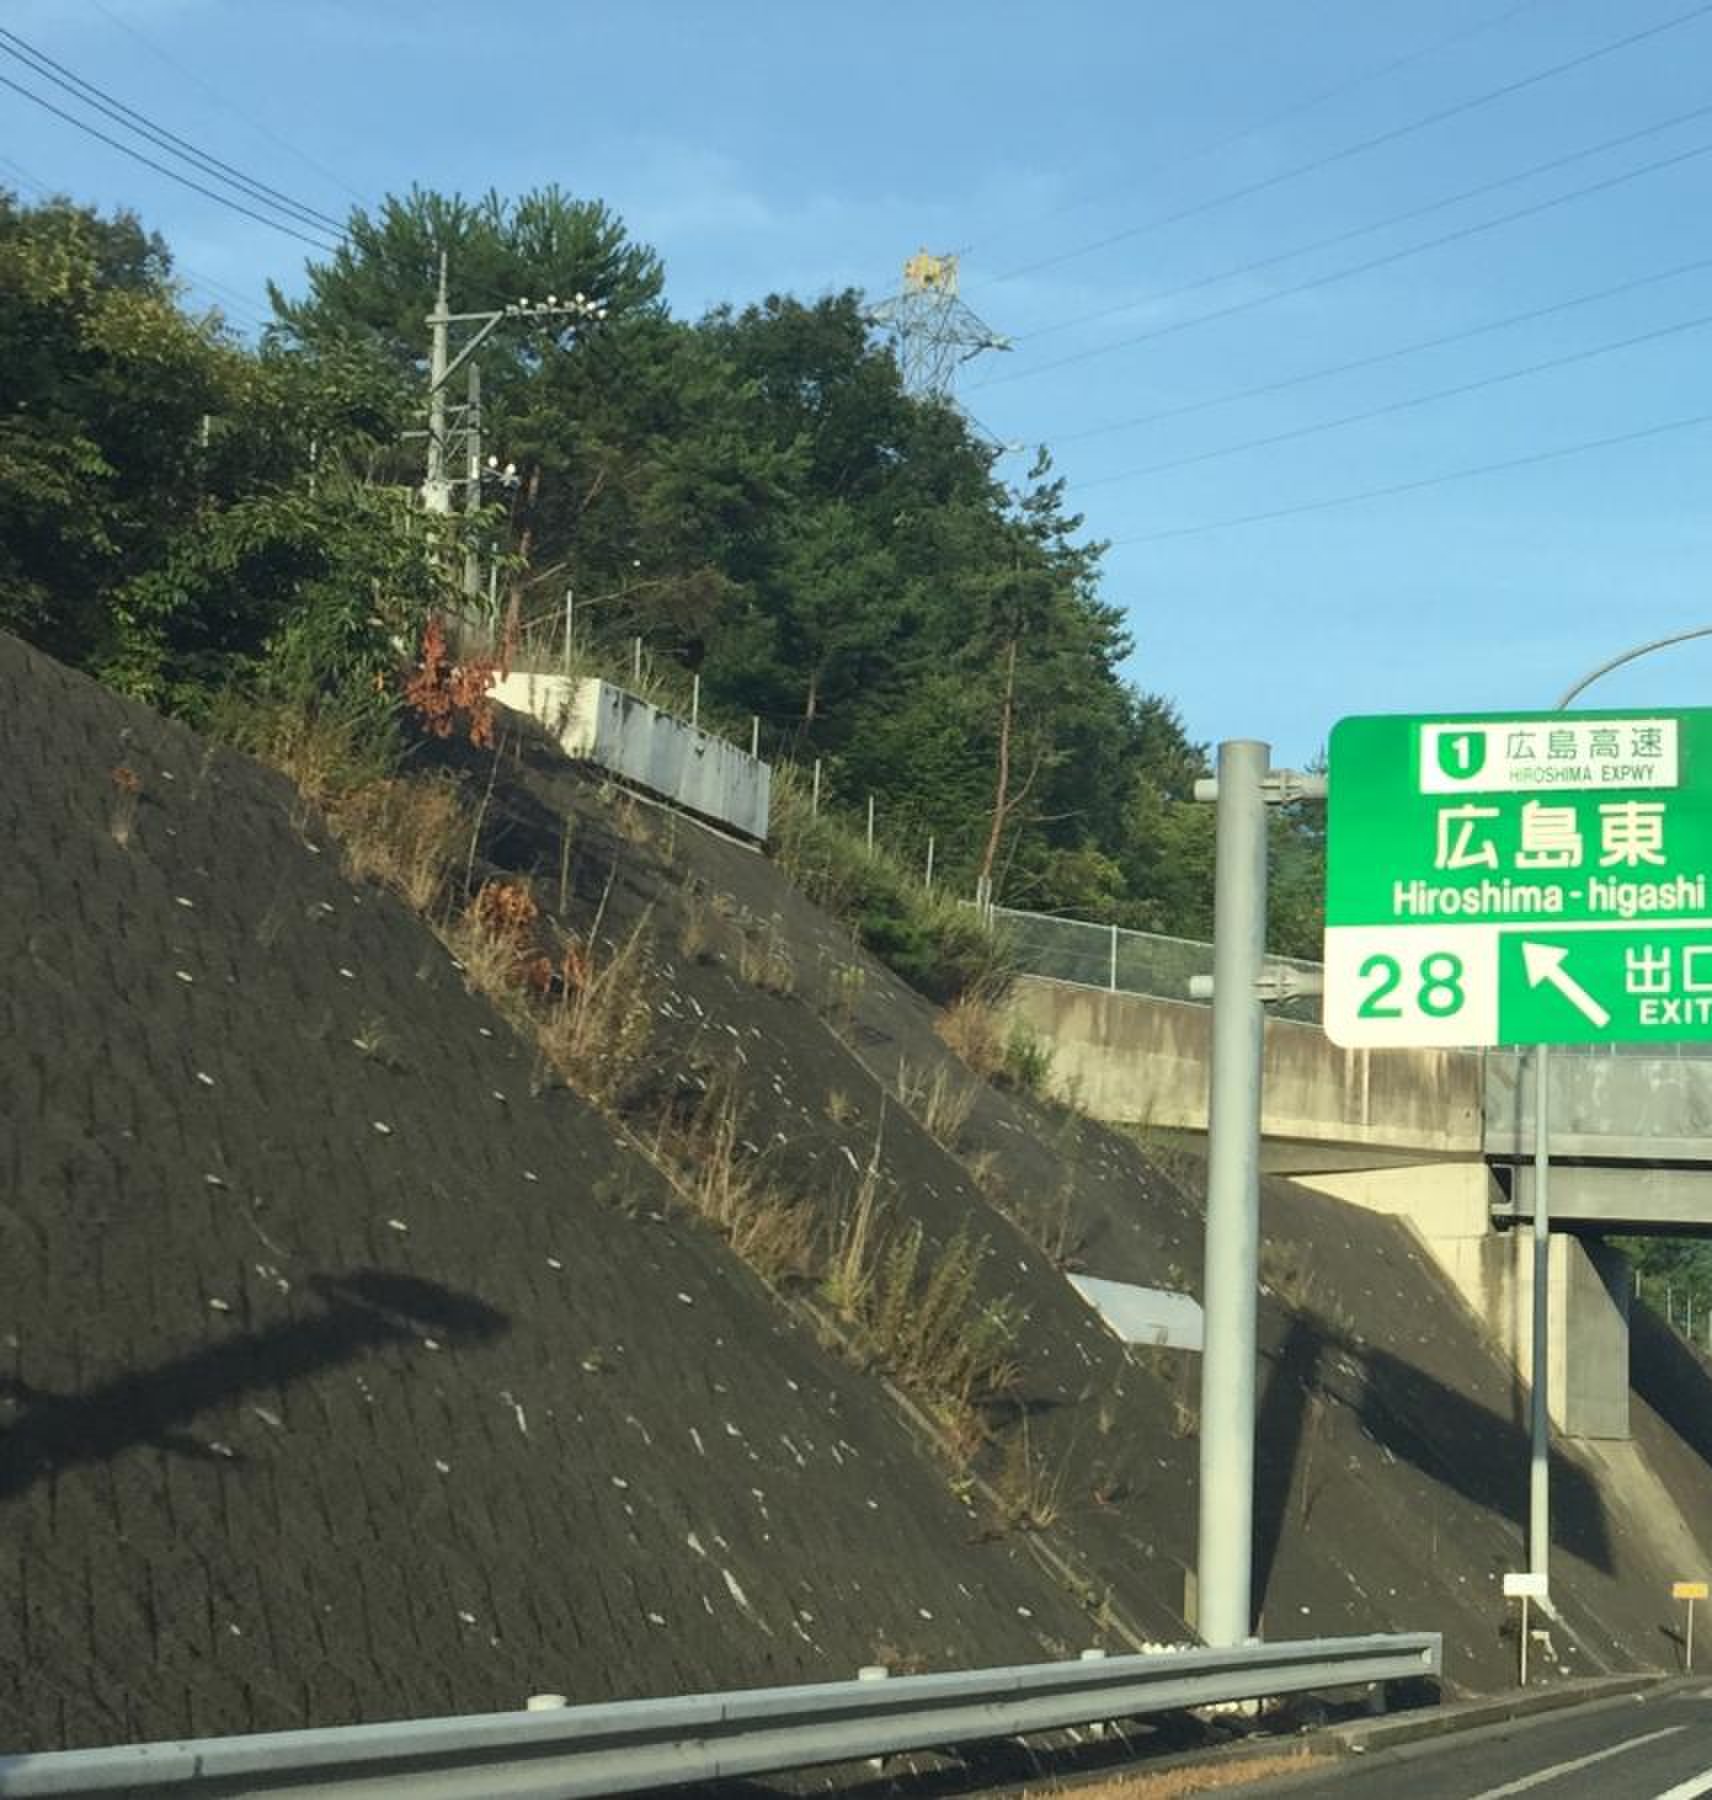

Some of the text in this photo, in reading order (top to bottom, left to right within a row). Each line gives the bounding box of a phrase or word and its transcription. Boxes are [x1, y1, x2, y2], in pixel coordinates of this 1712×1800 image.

[1451, 736, 1470, 769] 1
[1506, 727, 1663, 760] 広島高速
[1509, 764, 1655, 784] HIROSHIMA EXPWY
[1434, 800, 1667, 870] 広島東
[1357, 952, 1464, 1019] 28
